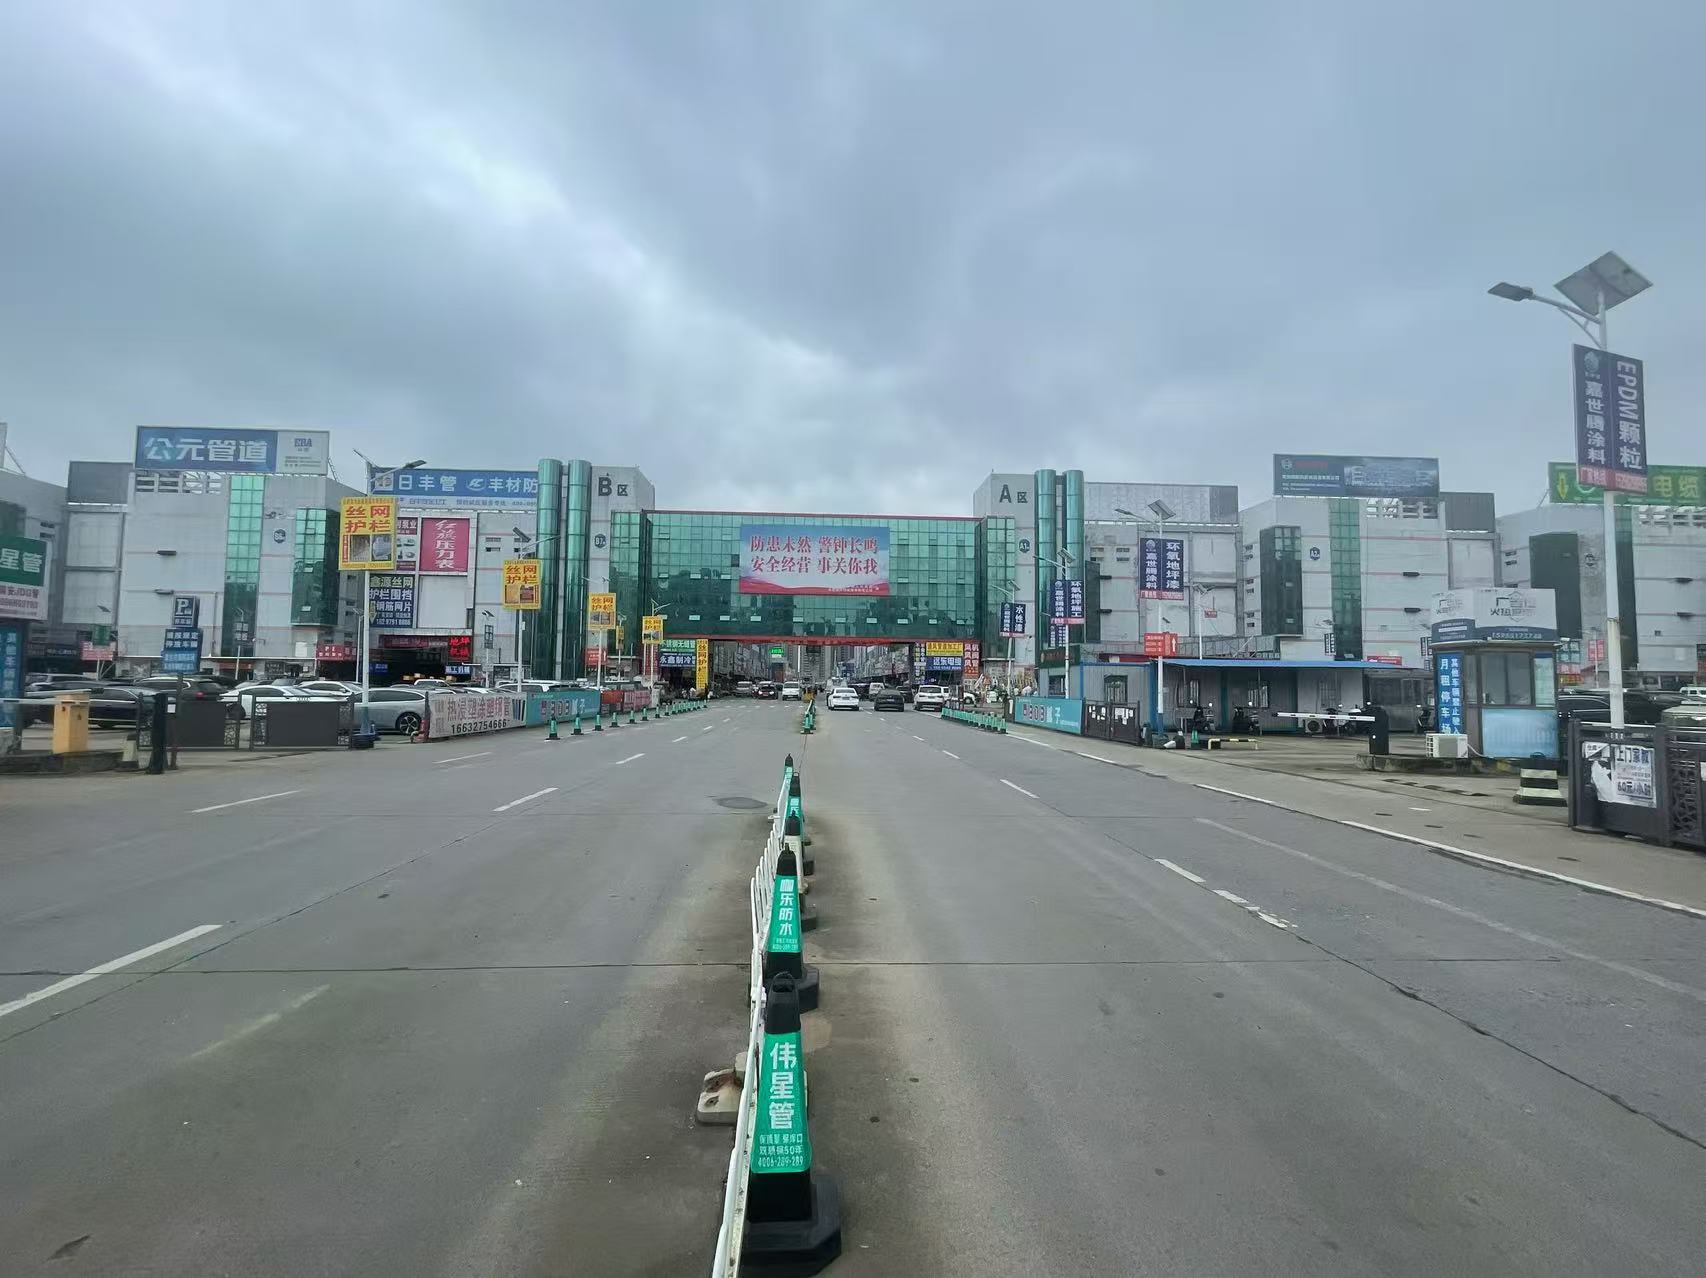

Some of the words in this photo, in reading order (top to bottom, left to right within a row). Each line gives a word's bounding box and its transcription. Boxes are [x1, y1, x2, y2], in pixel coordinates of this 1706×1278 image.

[144, 437, 268, 463] 公元管道
[398, 474, 457, 492] 日丰管
[1653, 475, 1699, 498] 电缆
[999, 484, 1028, 504] A区
[345, 505, 391, 519] 丝网
[345, 520, 391, 533] 护栏
[818, 536, 878, 554] 警钟长鸣
[0, 547, 42, 573] 星管
[751, 556, 811, 573] 安全经营
[818, 557, 878, 575] 事关你我
[1166, 542, 1180, 589] 环氧地坪漆
[506, 564, 537, 575] 丝网
[506, 575, 538, 585] 护栏
[369, 588, 412, 600] 护栏围挡
[175, 599, 189, 615] P
[376, 601, 412, 612] 钢筋网片
[1440, 658, 1451, 734] 月租停车场
[451, 718, 507, 734] 16632754666
[768, 1042, 797, 1130] 伟星管
